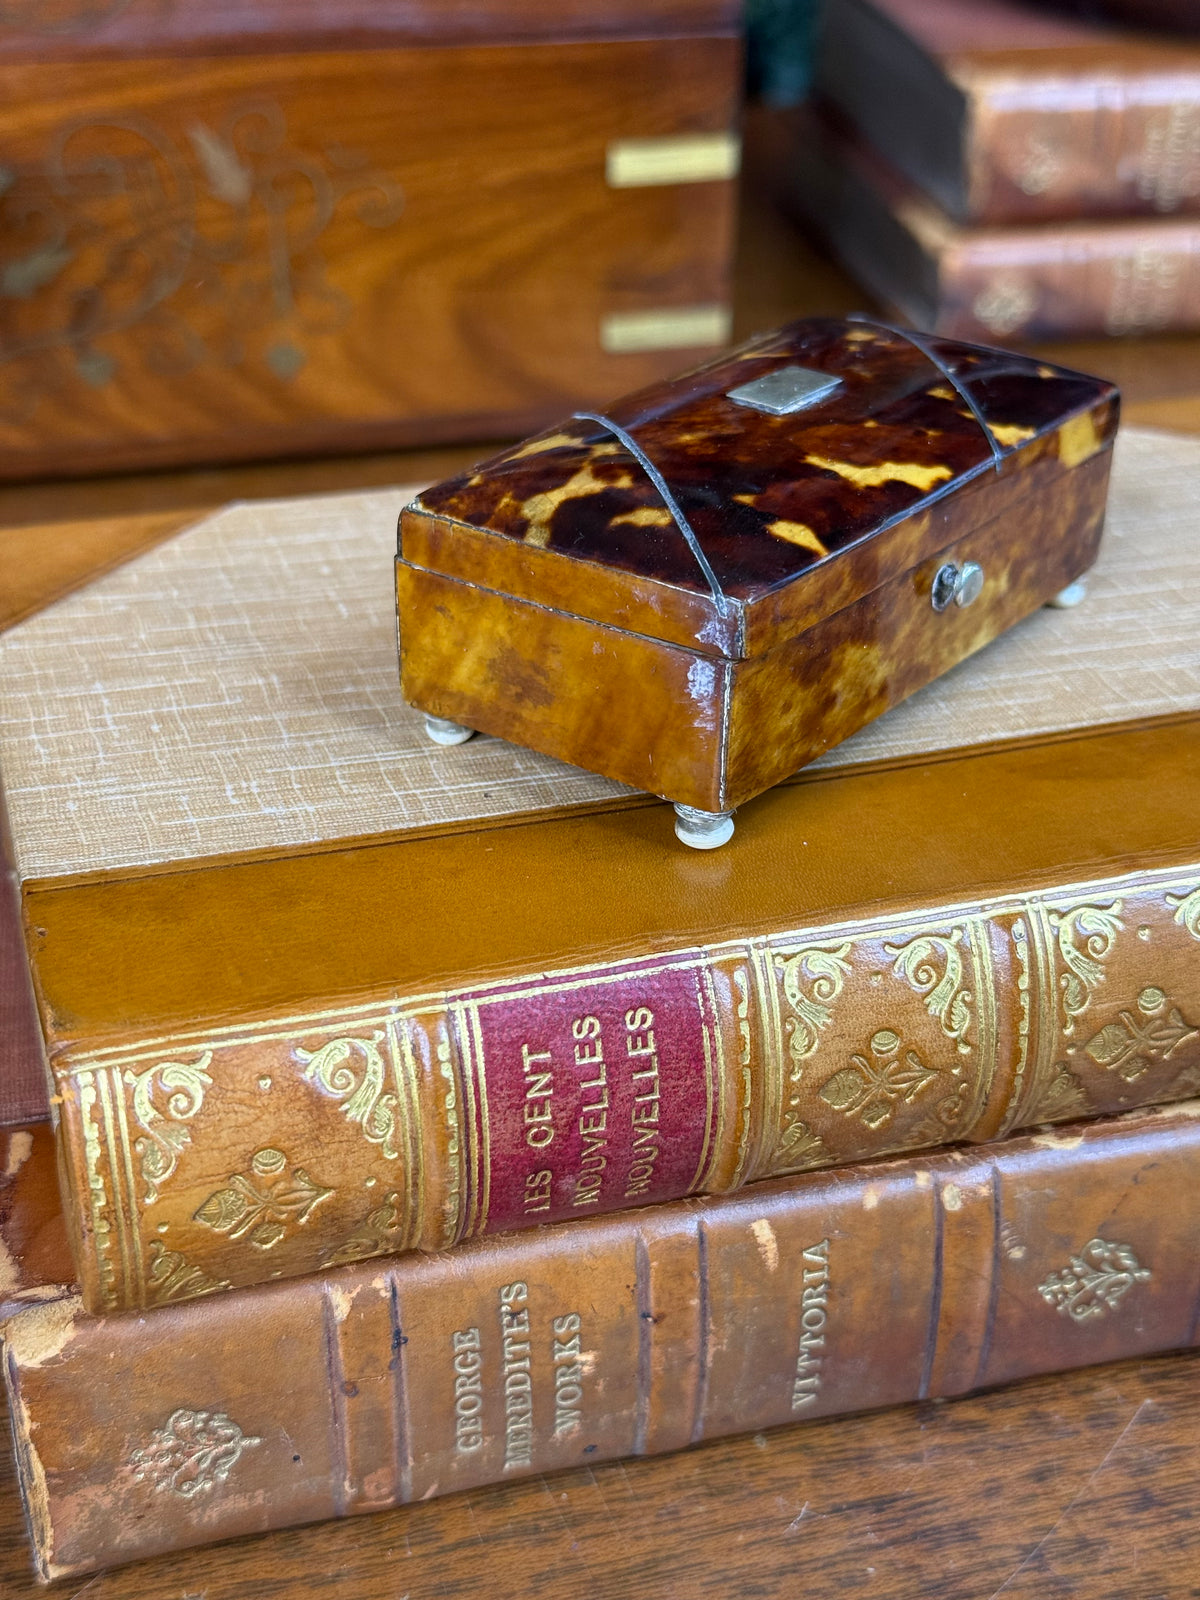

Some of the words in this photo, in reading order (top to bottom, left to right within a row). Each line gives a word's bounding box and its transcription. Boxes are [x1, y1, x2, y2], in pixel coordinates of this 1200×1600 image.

[521, 1044, 555, 1148] CENT
[572, 1015, 611, 1207] NOUVELLES
[625, 1006, 660, 1197] NOUVELLES
[524, 1169, 552, 1214] LES
[453, 1327, 481, 1454] GEORGE
[500, 1280, 532, 1472] MEREDITH'S
[553, 1312, 581, 1440] WORKS
[792, 1238, 830, 1411] VITTORIA
